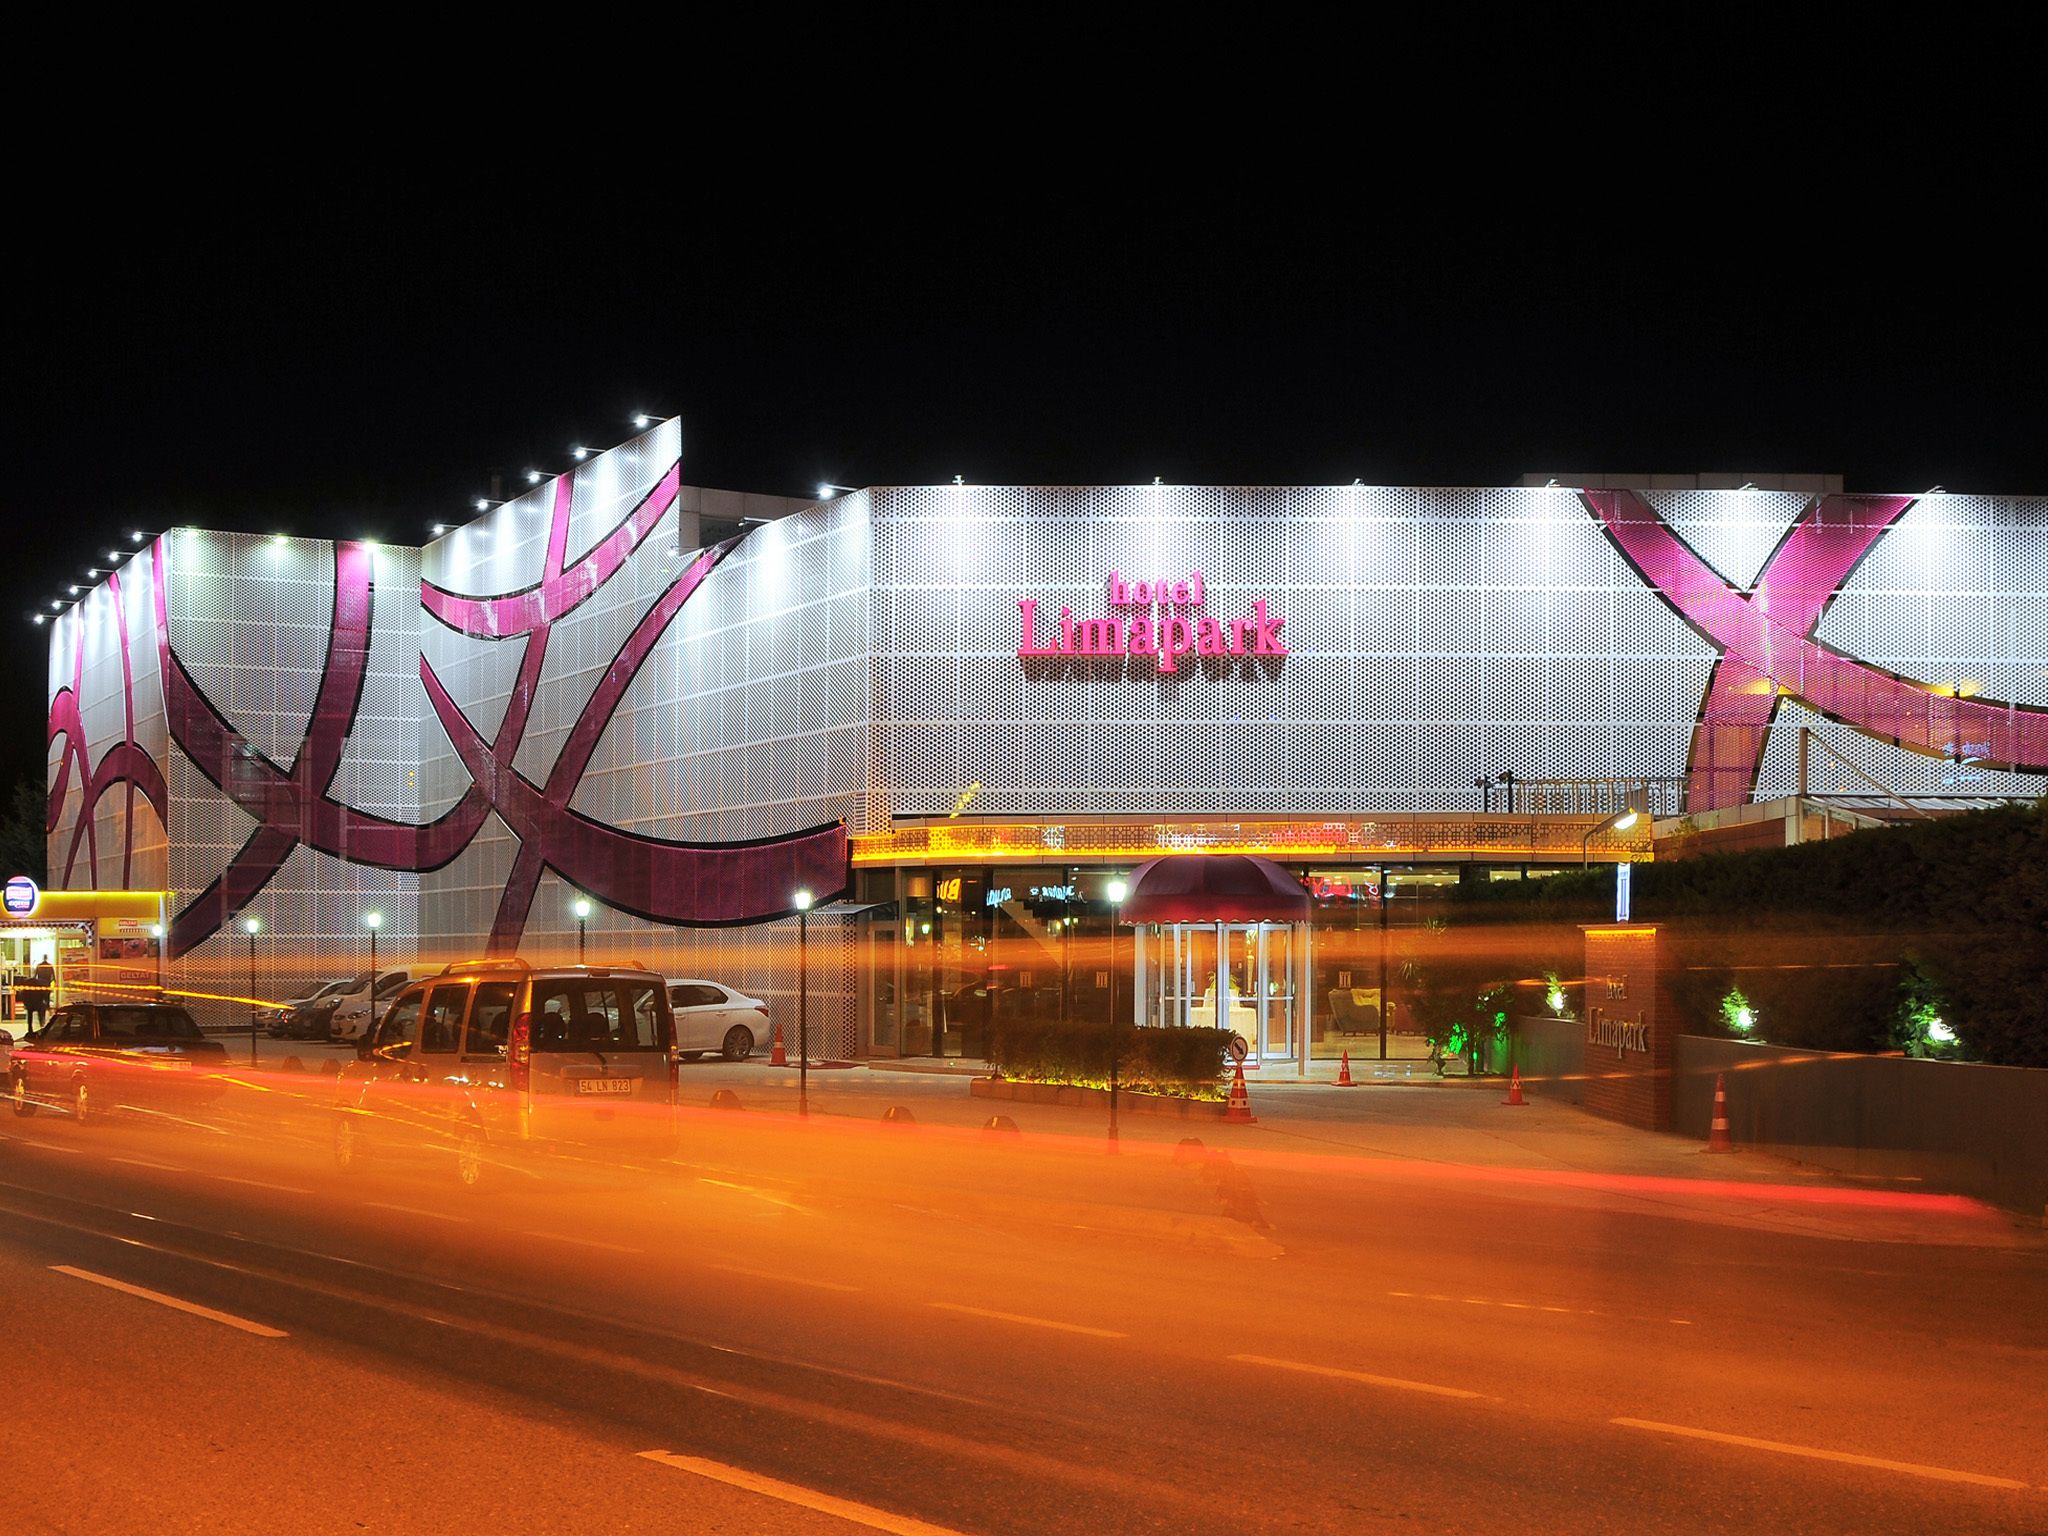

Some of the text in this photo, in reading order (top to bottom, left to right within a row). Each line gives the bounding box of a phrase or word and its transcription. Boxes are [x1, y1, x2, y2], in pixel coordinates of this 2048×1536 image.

[1108, 570, 1204, 605] hotel
[1016, 598, 1290, 673] Limapark
[1587, 1006, 1648, 1060] Limapark
[611, 1080, 629, 1091] 823
